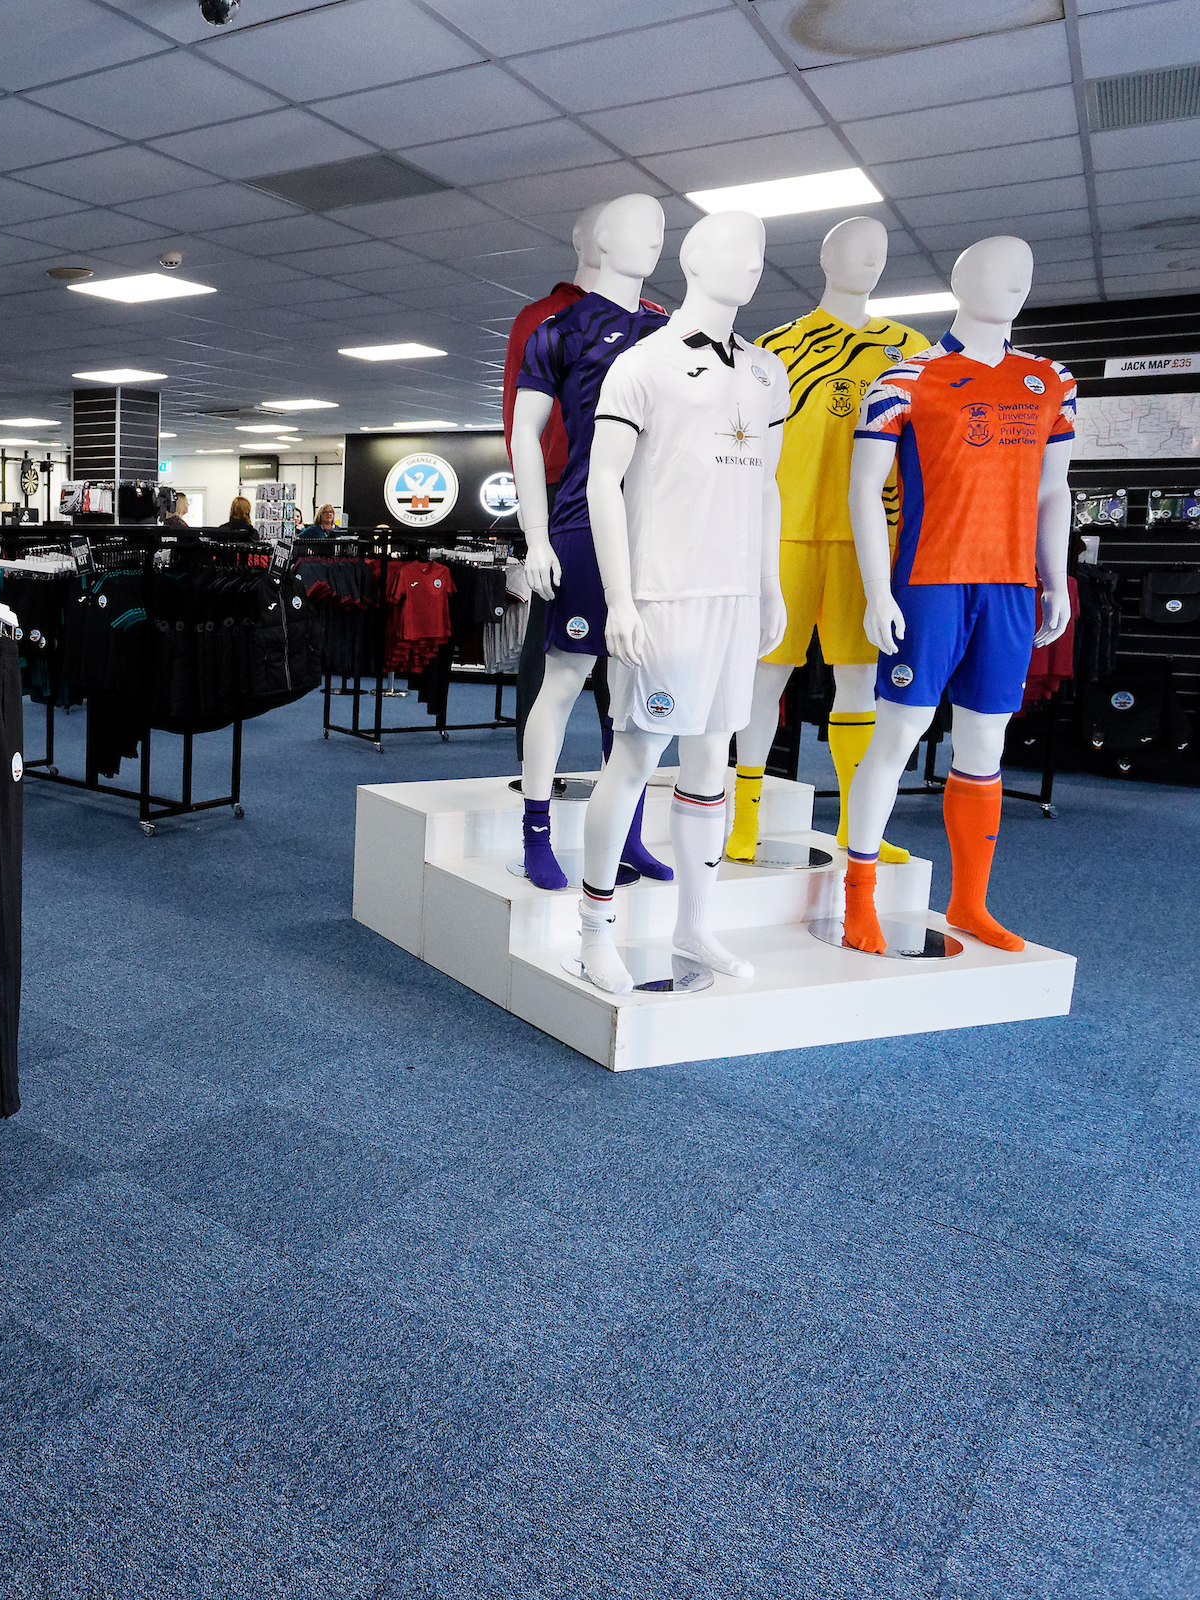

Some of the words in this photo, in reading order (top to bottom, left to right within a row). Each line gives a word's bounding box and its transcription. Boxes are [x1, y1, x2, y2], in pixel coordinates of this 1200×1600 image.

[1120, 361, 1146, 371] JACK
[1171, 358, 1192, 368] £35
[997, 403, 1039, 411] Swansea
[997, 412, 1039, 421] University
[406, 457, 437, 466] SWANSEA
[715, 456, 763, 467] WESTACRES
[402, 513, 418, 522] CITY
